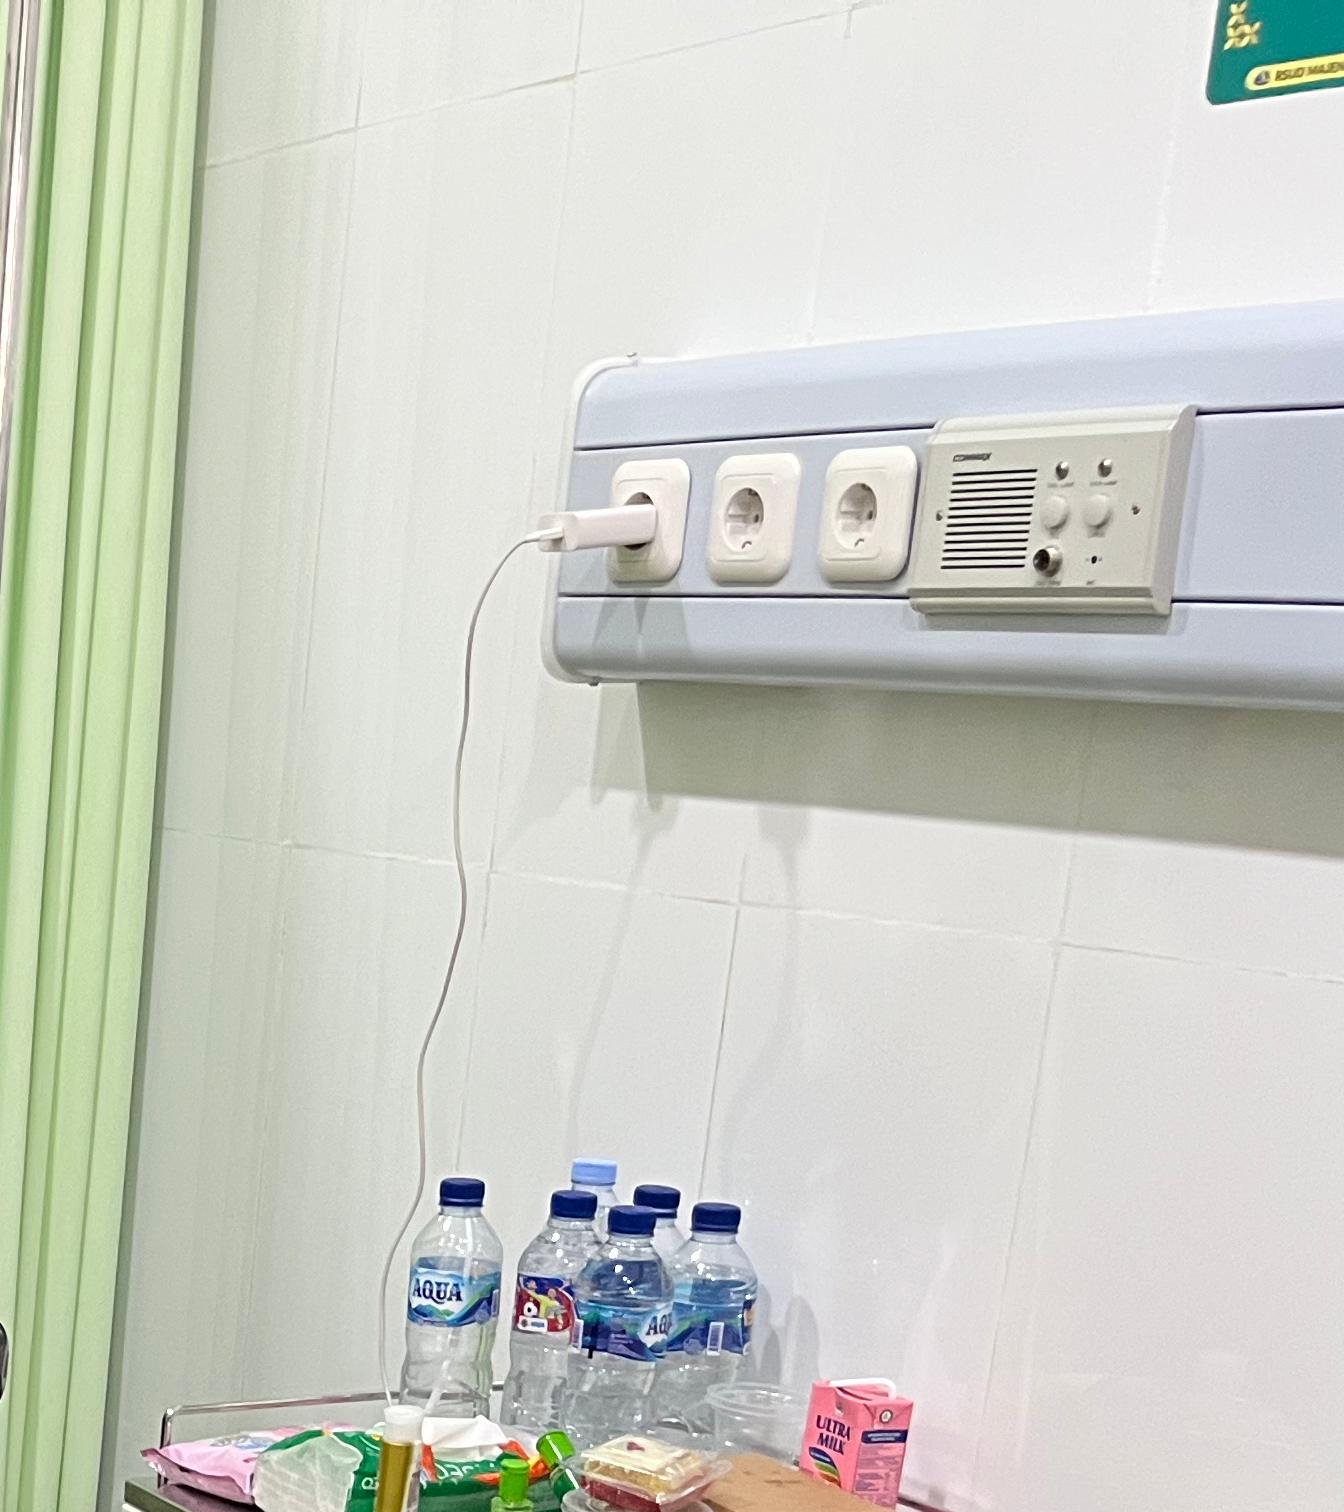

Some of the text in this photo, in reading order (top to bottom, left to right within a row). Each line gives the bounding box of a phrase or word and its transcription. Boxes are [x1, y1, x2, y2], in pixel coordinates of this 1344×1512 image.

[412, 1277, 463, 1304] AQUA
[816, 1414, 851, 1441] ULTRA
[816, 1432, 847, 1456] MILK
